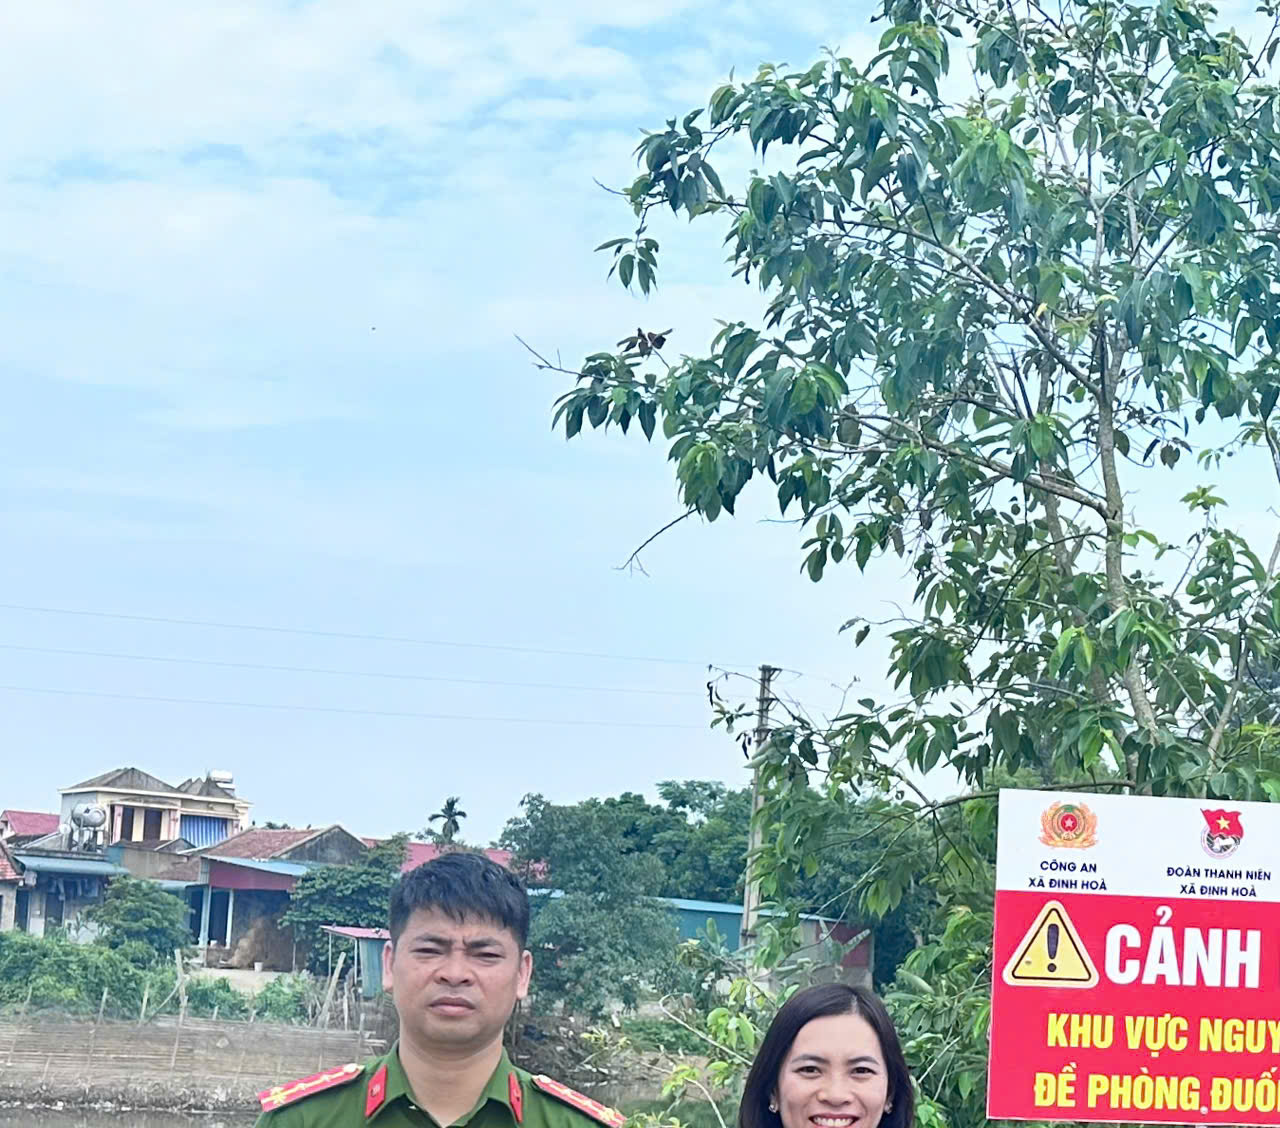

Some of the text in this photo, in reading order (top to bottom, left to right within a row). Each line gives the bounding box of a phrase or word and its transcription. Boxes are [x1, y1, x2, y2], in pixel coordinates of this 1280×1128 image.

[1040, 859, 1097, 873] CÔNG AN
[1167, 865, 1271, 881] ĐOÀN THANH NIÊN
[1028, 875, 1045, 888] XÃ
[1180, 883, 1196, 895] XÃ
[1231, 885, 1257, 897] HOÀ
[1104, 905, 1261, 989] CẢNH
[1047, 1013, 1114, 1049] KHU
[1125, 1013, 1188, 1058] VỰC
[1034, 1062, 1077, 1107] ĐỀ
[1087, 1067, 1200, 1111] PHÒNG
